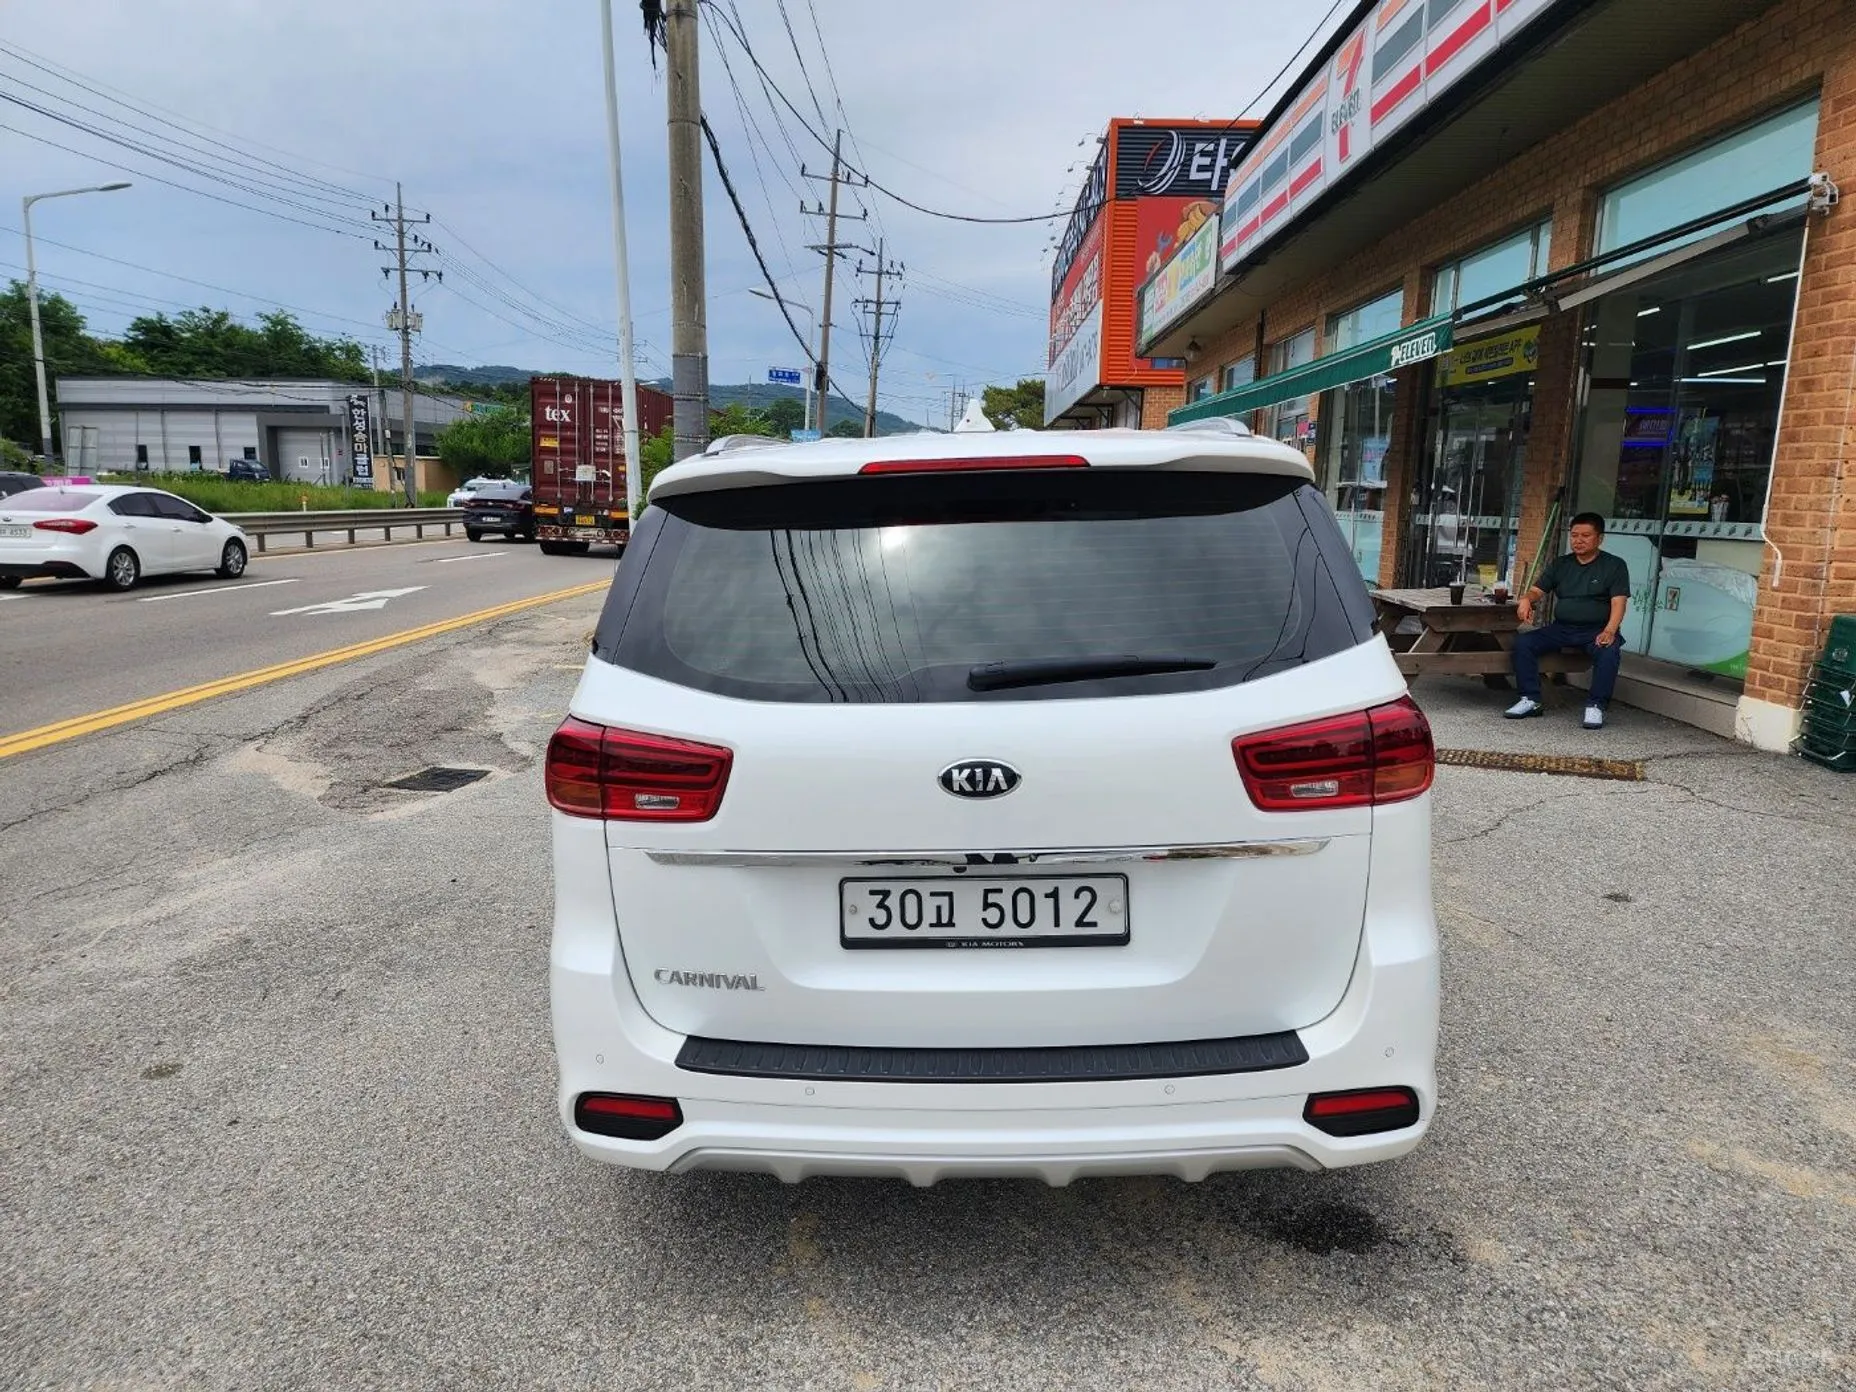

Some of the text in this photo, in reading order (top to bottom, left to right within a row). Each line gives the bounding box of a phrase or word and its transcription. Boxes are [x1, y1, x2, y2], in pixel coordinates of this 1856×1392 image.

[545, 405, 571, 422] tex
[951, 768, 1008, 792] KIA
[868, 886, 1098, 930] 30고 5012
[654, 967, 766, 991] CARNIVAL
